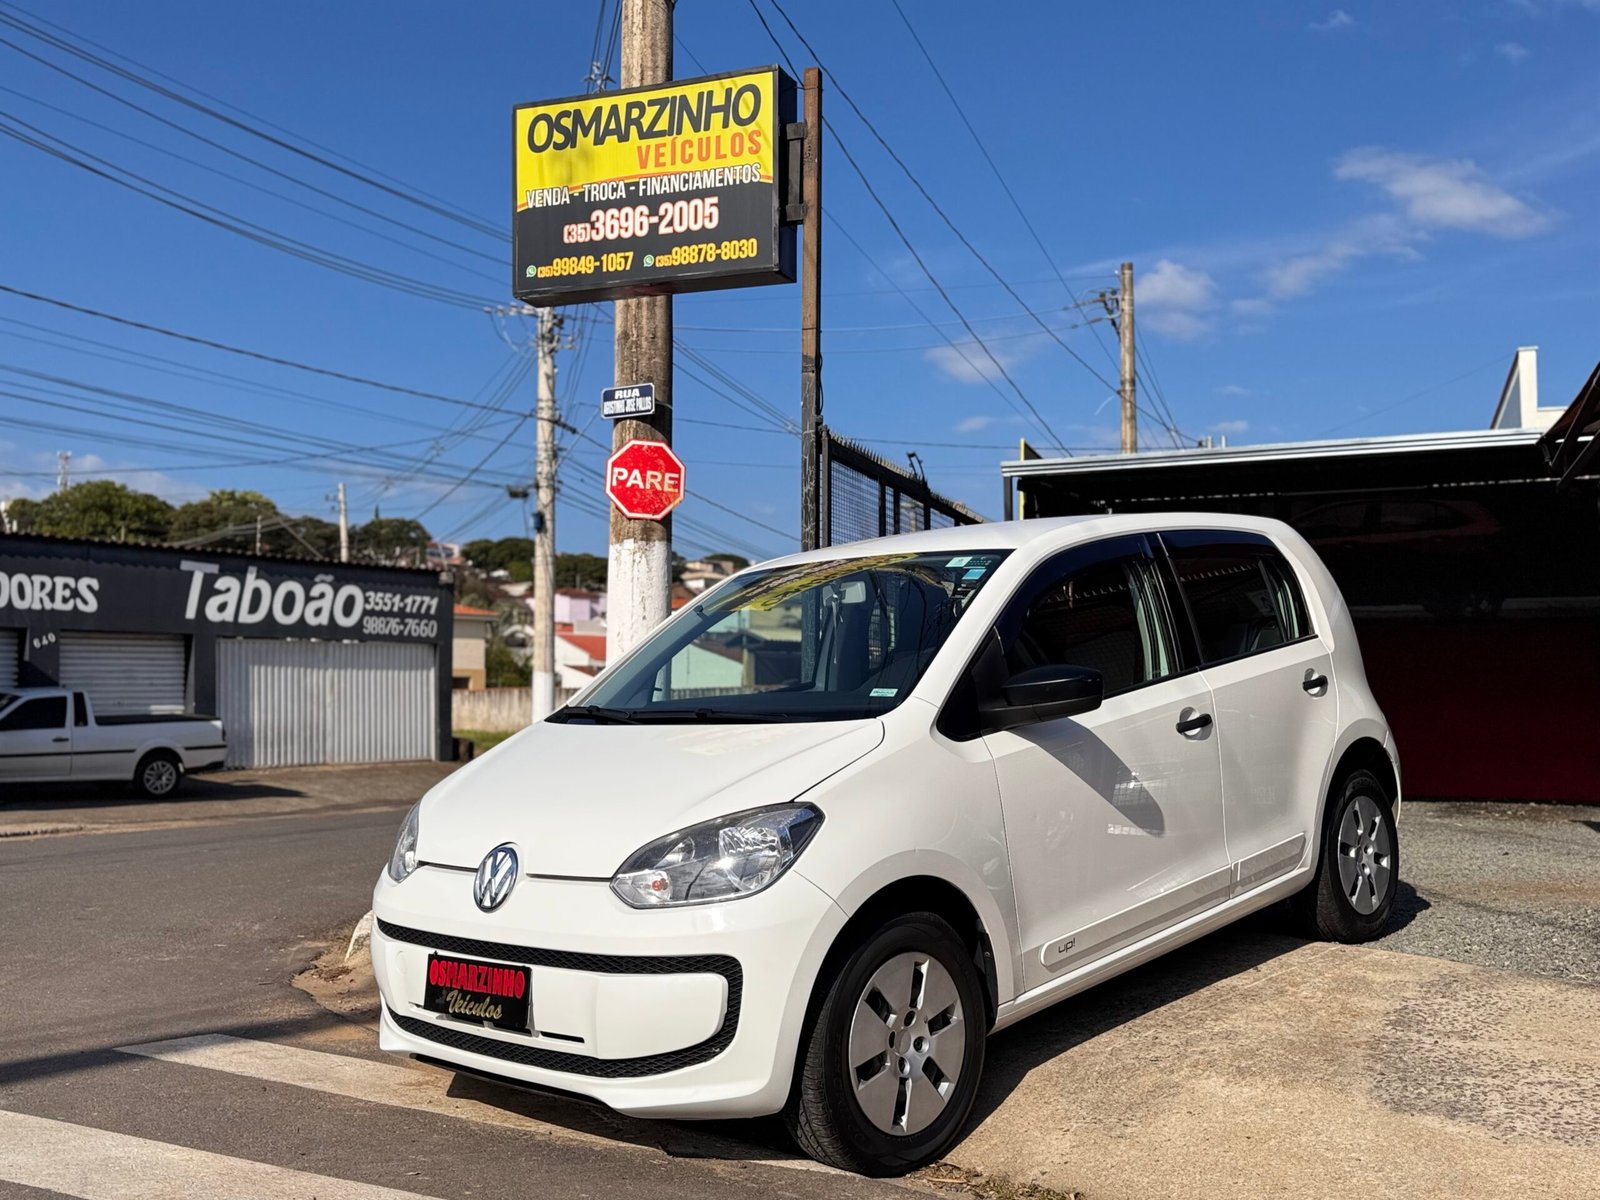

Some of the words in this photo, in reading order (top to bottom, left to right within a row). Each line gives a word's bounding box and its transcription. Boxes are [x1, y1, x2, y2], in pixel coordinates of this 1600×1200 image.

[527, 83, 762, 153] OSMARZINHO
[637, 129, 762, 170] VEÍCULOS
[526, 186, 571, 209] VENDA
[582, 180, 626, 203] TROCA
[638, 163, 762, 197] FINANCIAMENTOS
[614, 388, 640, 400] RUA
[612, 467, 679, 493] PARE
[180, 560, 365, 628] Taboão
[1058, 936, 1076, 953] up!
[429, 958, 525, 999] OSMARZINHO
